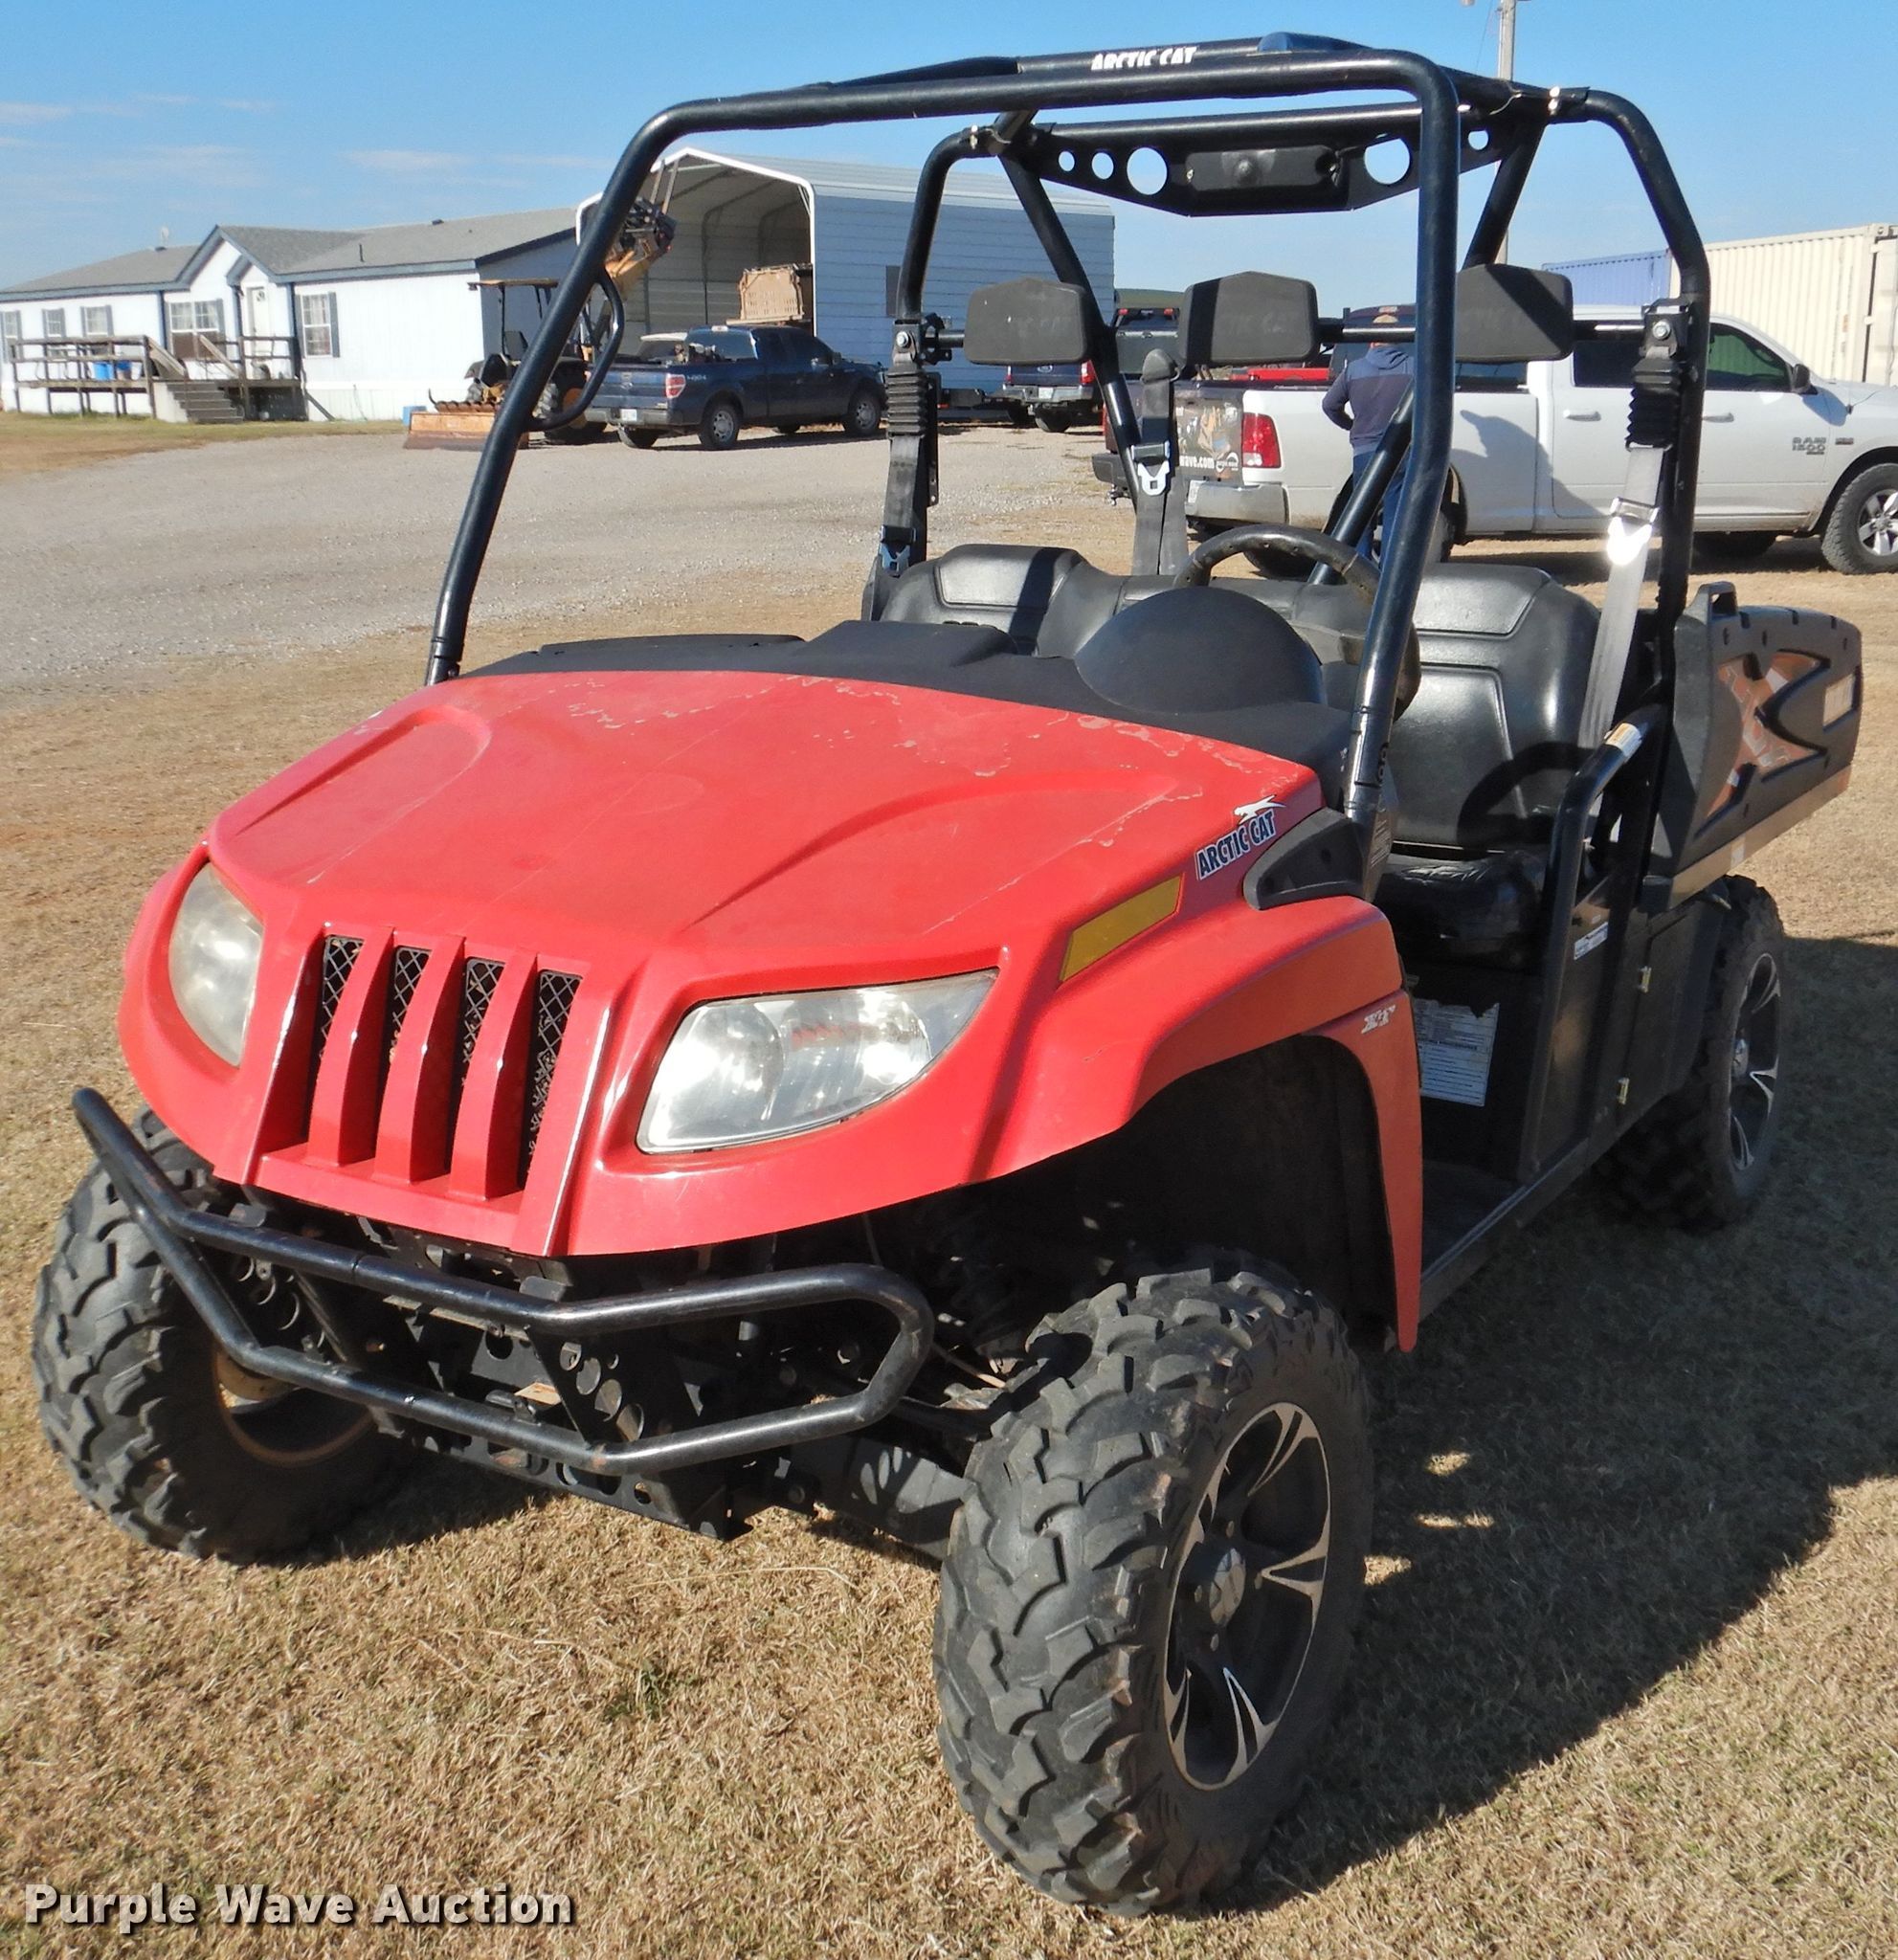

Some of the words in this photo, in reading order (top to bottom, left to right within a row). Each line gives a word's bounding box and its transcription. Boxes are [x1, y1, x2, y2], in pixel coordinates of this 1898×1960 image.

[1091, 49, 1157, 71] ARCTIC
[1159, 46, 1198, 65] CAT
[1195, 826, 1250, 880] ARCTIC
[1249, 810, 1277, 845] CAT
